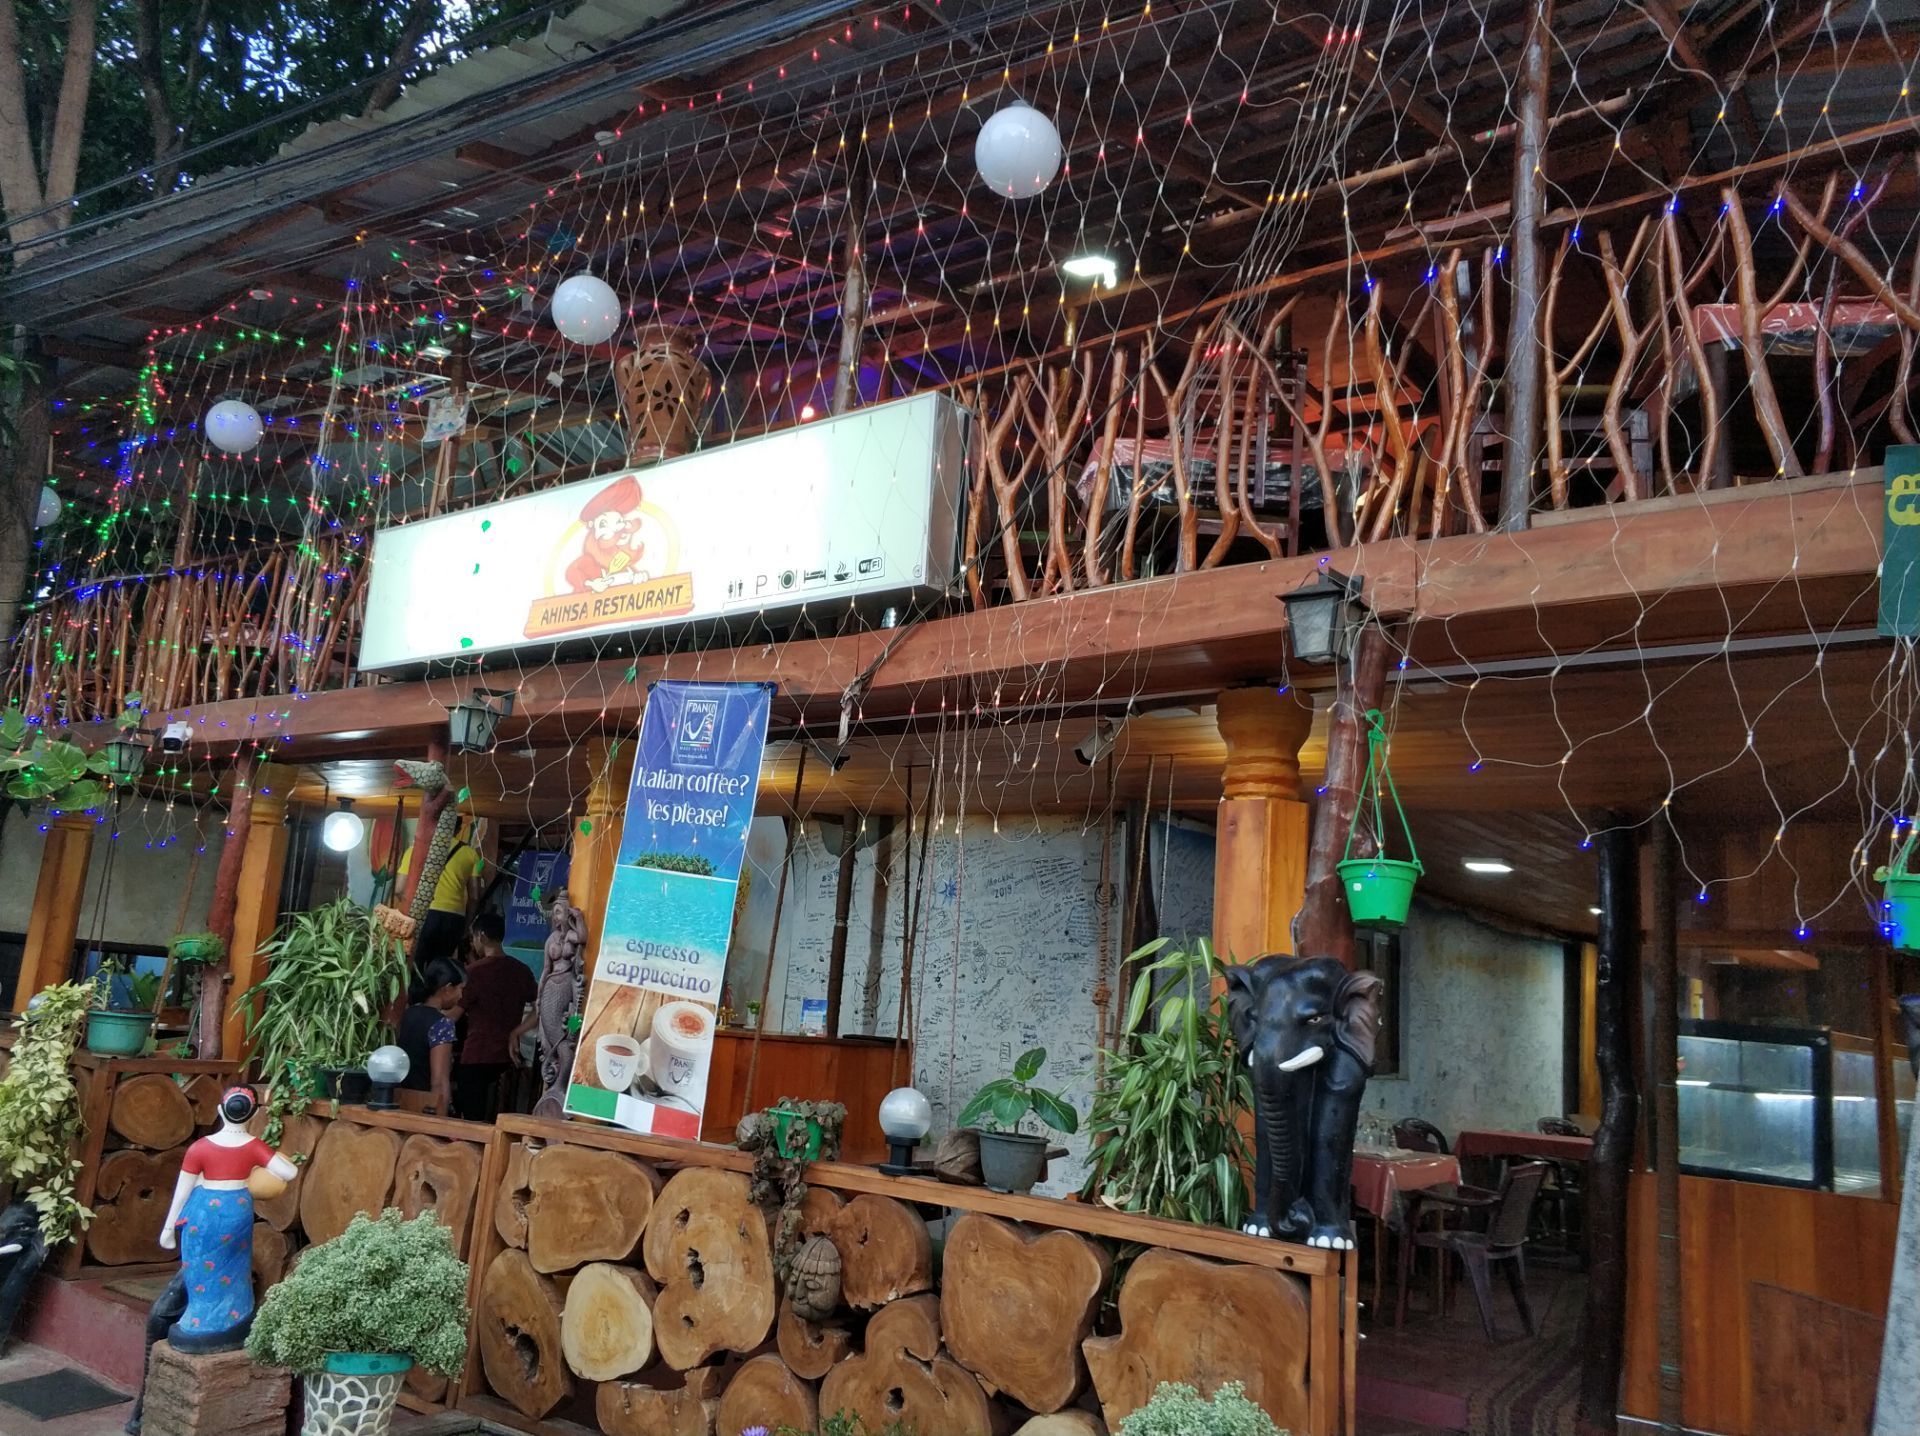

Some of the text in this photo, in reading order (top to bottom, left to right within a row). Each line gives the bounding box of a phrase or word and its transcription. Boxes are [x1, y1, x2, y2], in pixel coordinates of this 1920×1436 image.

[754, 574, 769, 596] P
[540, 584, 684, 626] AHINSA RESTAURANT
[636, 766, 751, 797] Italian coffee?
[647, 798, 729, 828] Yes please!
[626, 937, 700, 965] espresso
[606, 959, 712, 994] cappuccino
